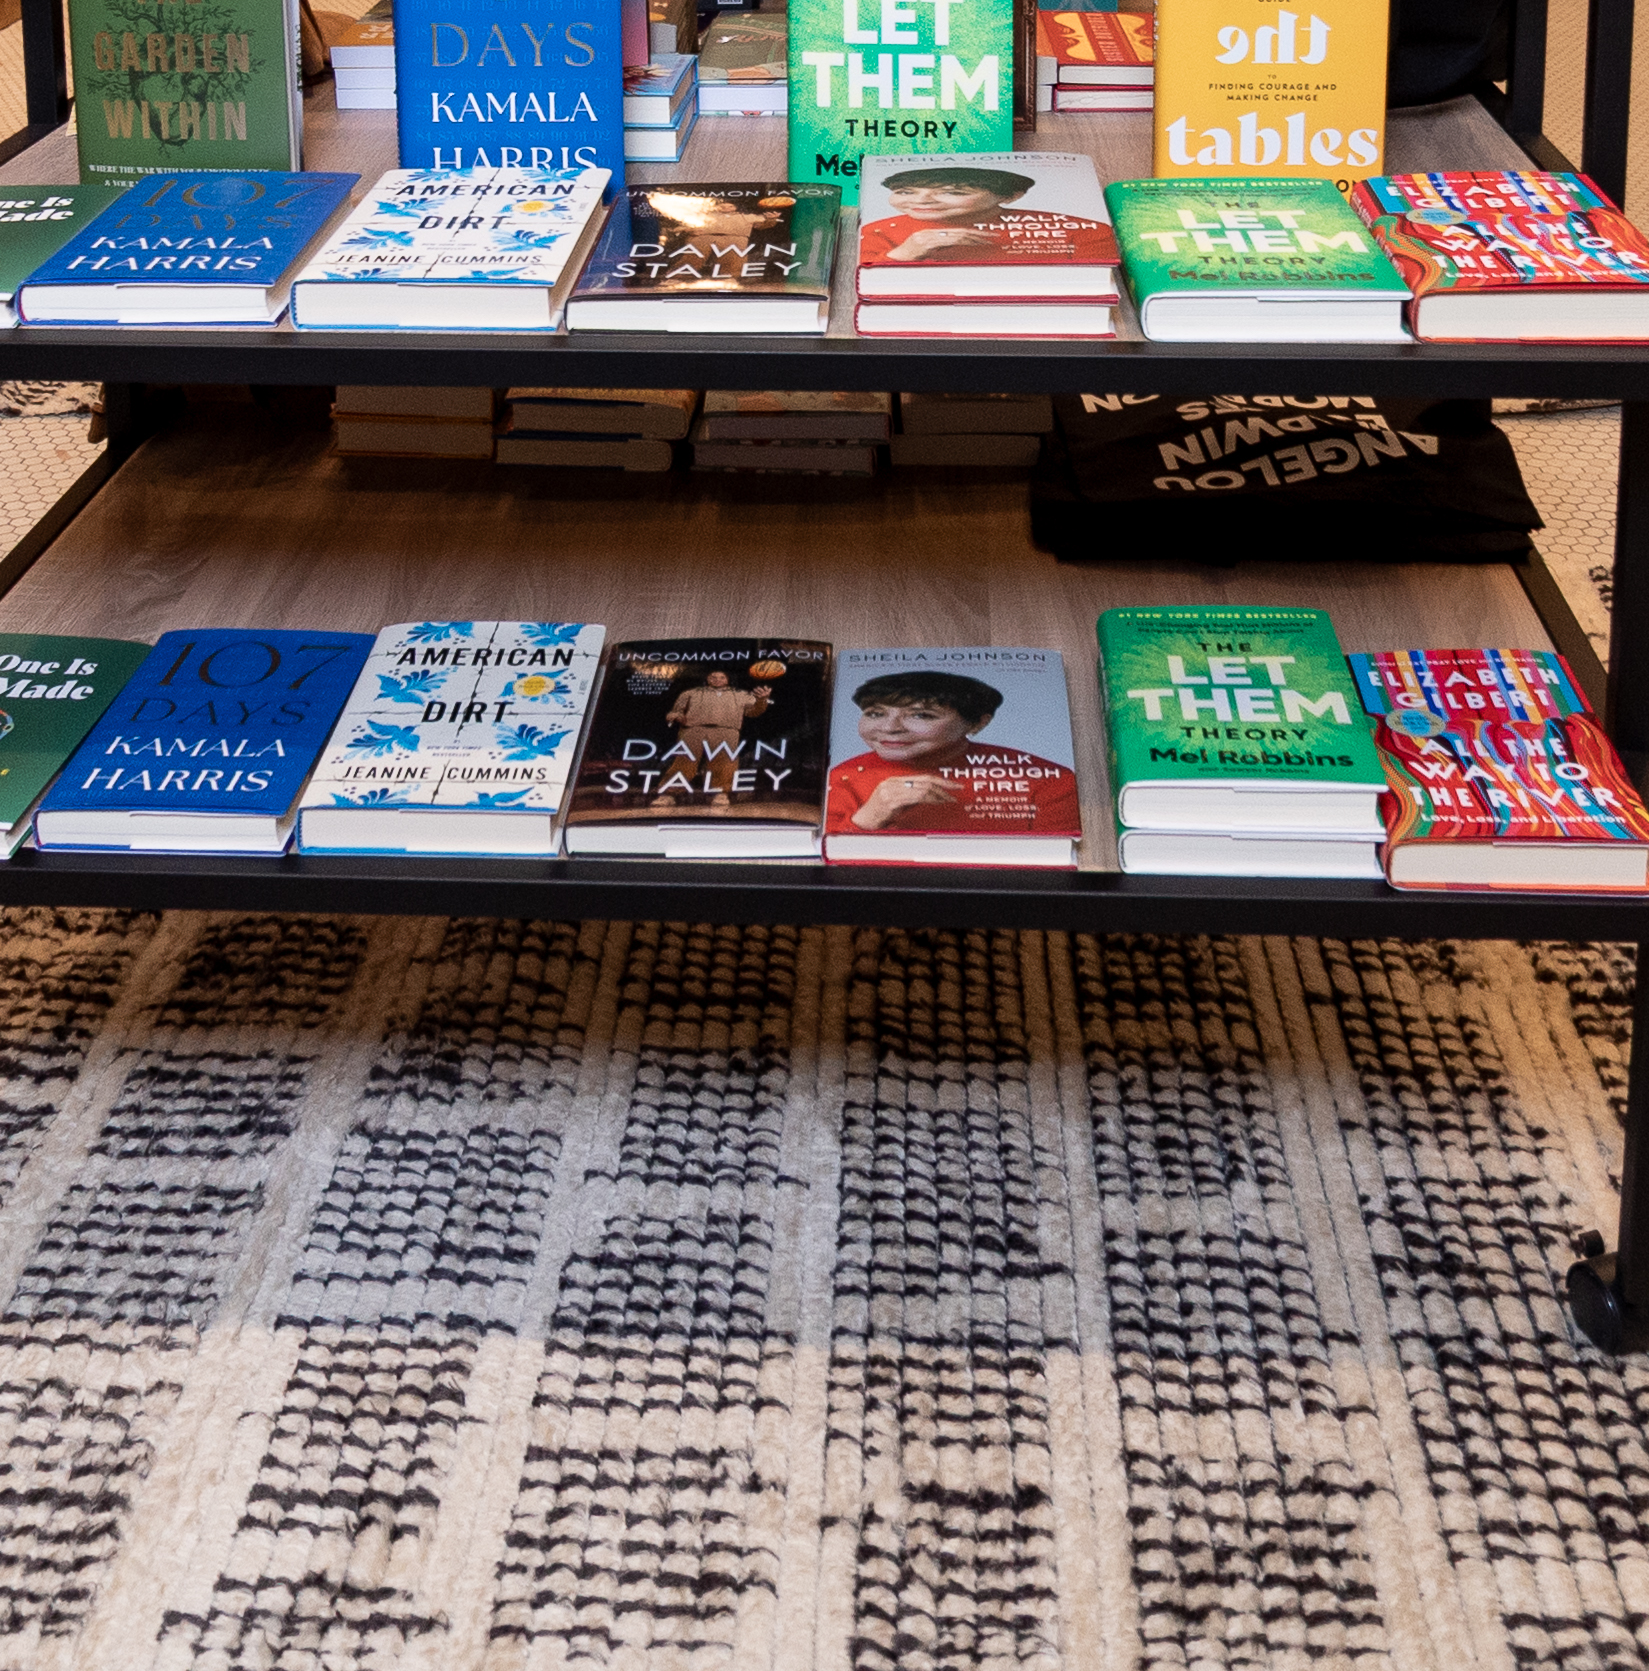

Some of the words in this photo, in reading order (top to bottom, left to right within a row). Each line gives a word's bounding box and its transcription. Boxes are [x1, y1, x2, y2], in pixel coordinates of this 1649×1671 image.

[95, 32, 250, 75] GARDEN
[430, 21, 596, 67] DAYS
[802, 52, 1000, 111] THEM
[430, 92, 598, 123] KAMALA
[102, 100, 247, 141] WITHIN
[845, 119, 958, 139] THEORY
[1165, 112, 1379, 169] tables
[1153, 432, 1440, 493] ANGELOU
[397, 646, 573, 667] AMERICAN
[421, 701, 514, 723] DIRT
[622, 738, 788, 761] DAWN
[966, 754, 1032, 765] WALK
[1150, 747, 1215, 766] Mel
[1219, 749, 1354, 768] Robbins
[342, 765, 429, 780] JEANINE
[448, 765, 548, 780] CUMMINS
[605, 769, 792, 793] STALEY
[939, 766, 1060, 779] THROUGH
